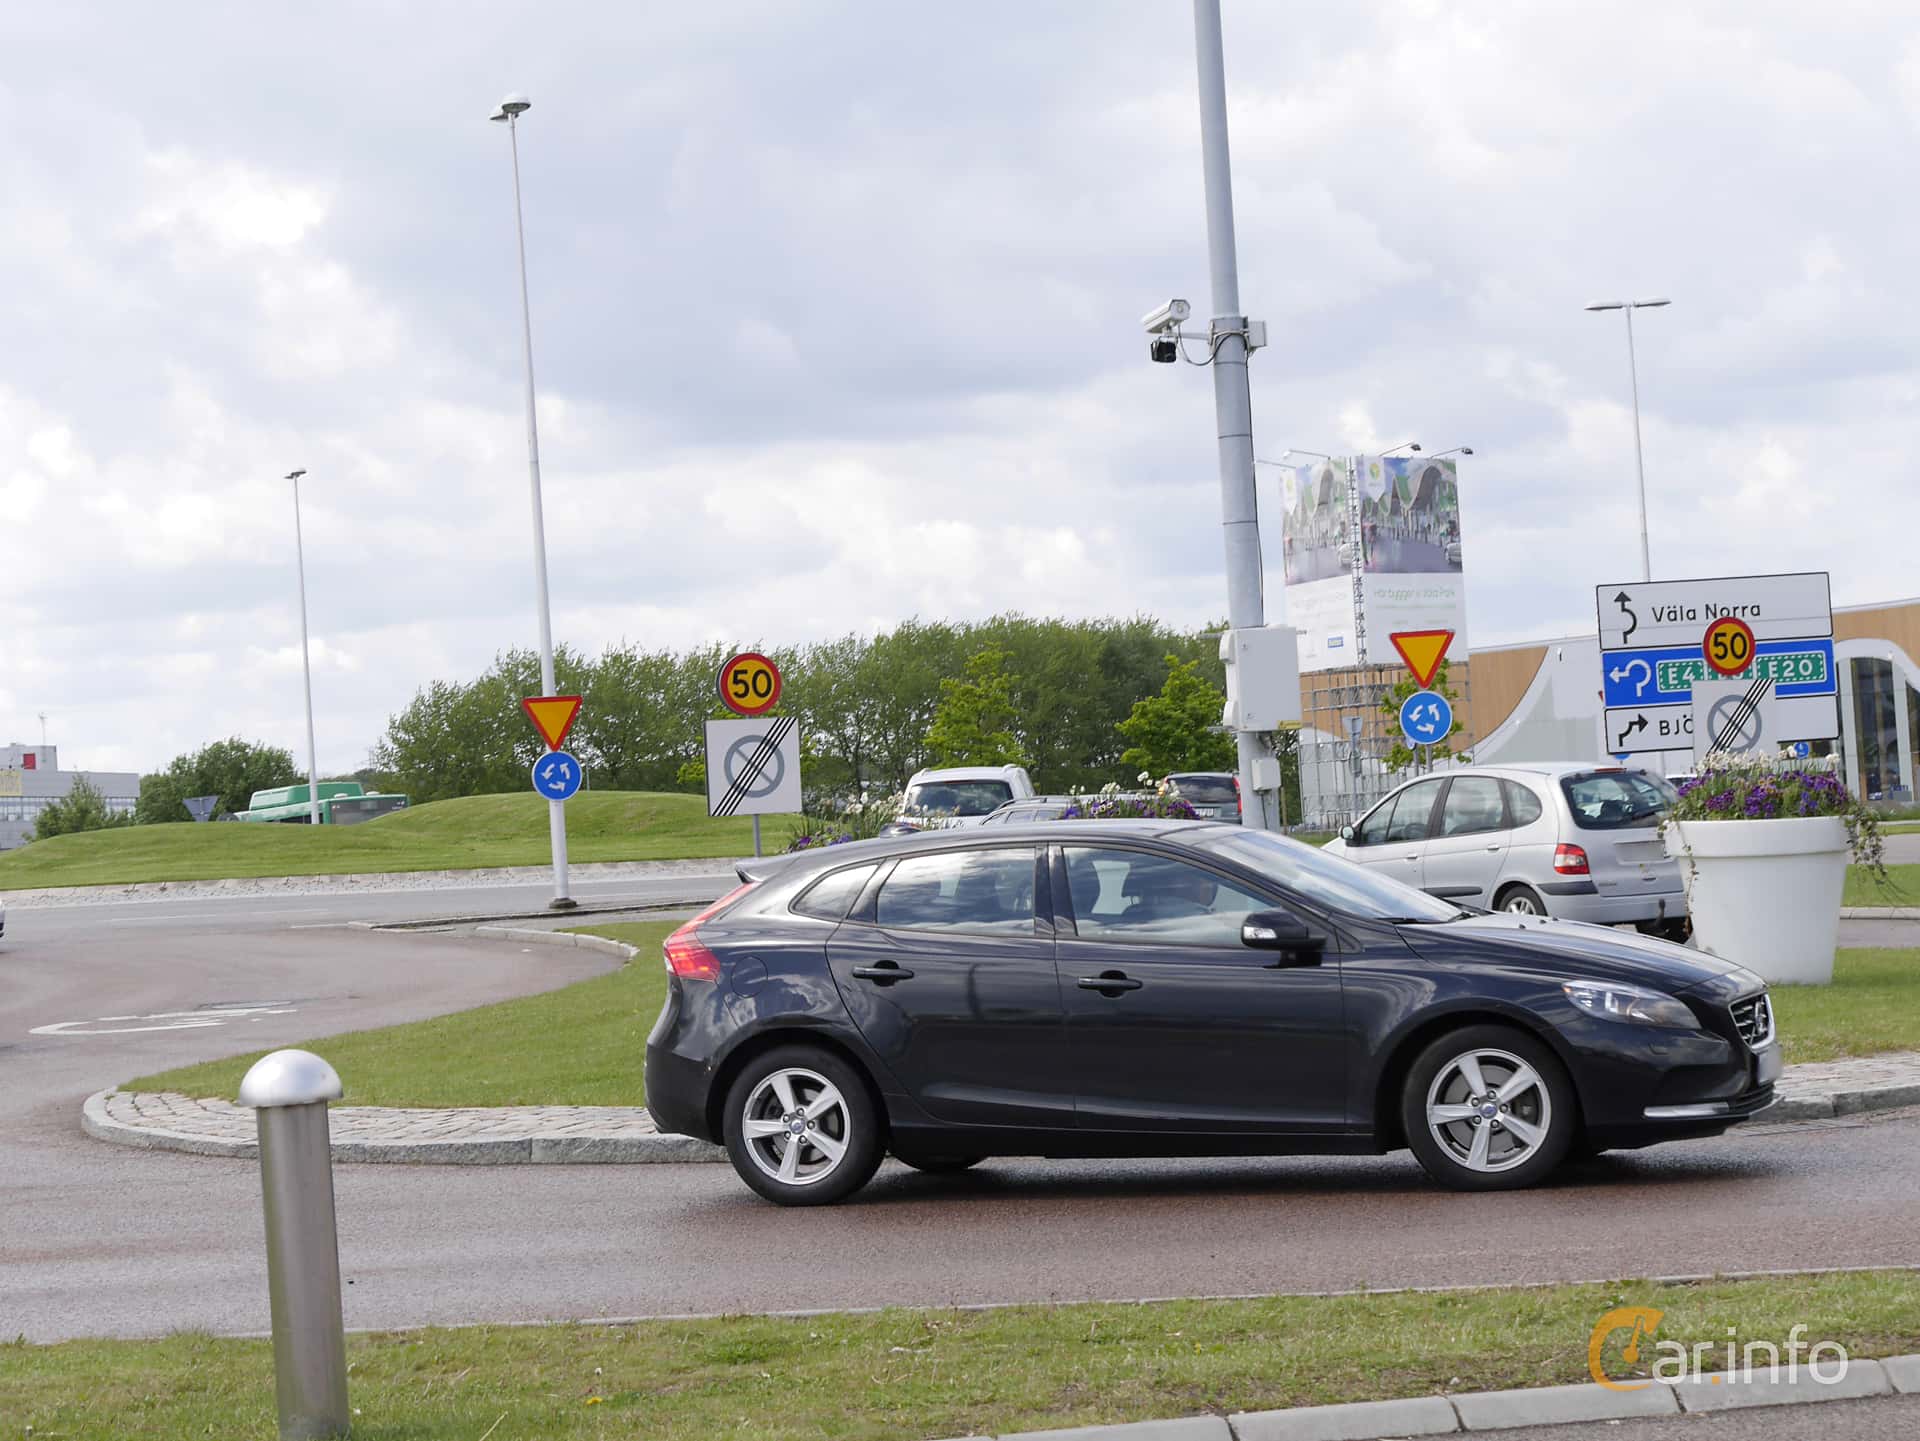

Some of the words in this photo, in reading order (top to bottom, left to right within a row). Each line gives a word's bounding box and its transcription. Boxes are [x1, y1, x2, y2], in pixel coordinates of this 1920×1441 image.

[1652, 605, 1696, 622] Väla
[1705, 603, 1761, 619] Norra
[1713, 632, 1747, 660] 50
[733, 669, 772, 698] 50
[1668, 668, 1695, 685] E4
[1768, 659, 1813, 678] E20
